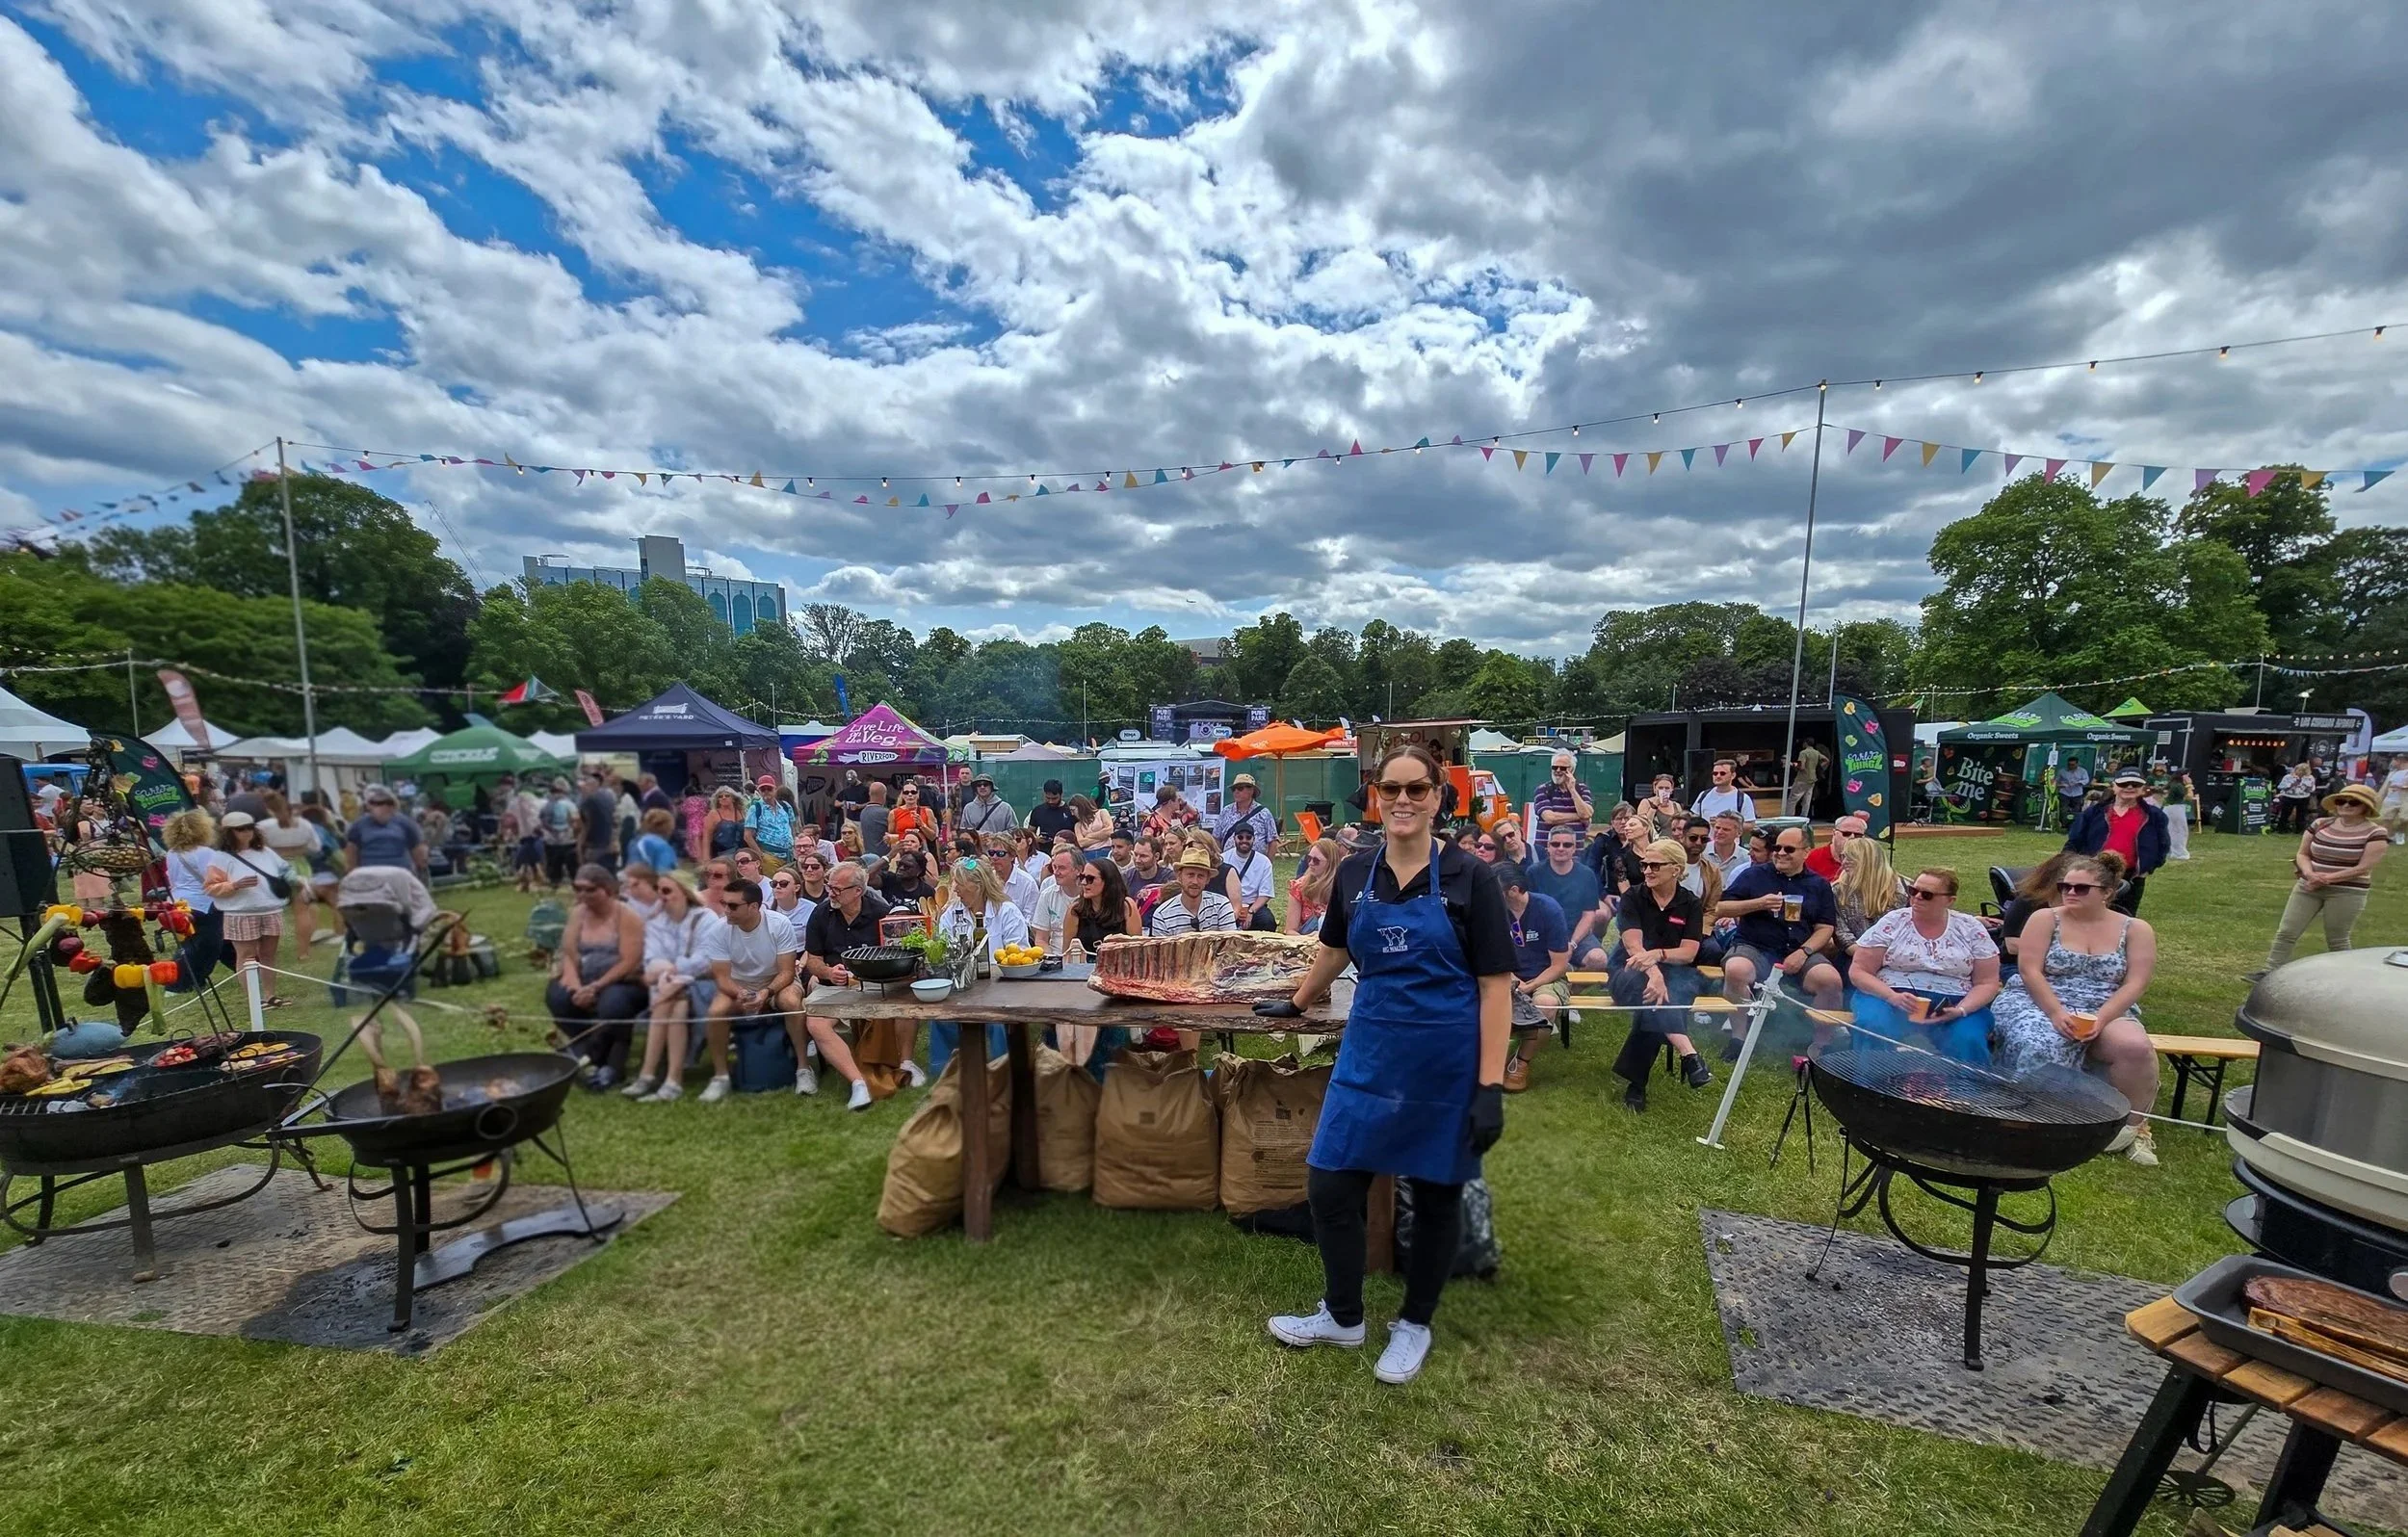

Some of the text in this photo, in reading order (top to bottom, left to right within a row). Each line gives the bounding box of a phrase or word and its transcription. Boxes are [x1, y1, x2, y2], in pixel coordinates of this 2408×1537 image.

[862, 731, 898, 746] Veg
[1967, 732, 1994, 741] Organic
[861, 752, 896, 762] RIVERFORD
[1956, 756, 1995, 786] Bite
[1955, 780, 1985, 800] me
